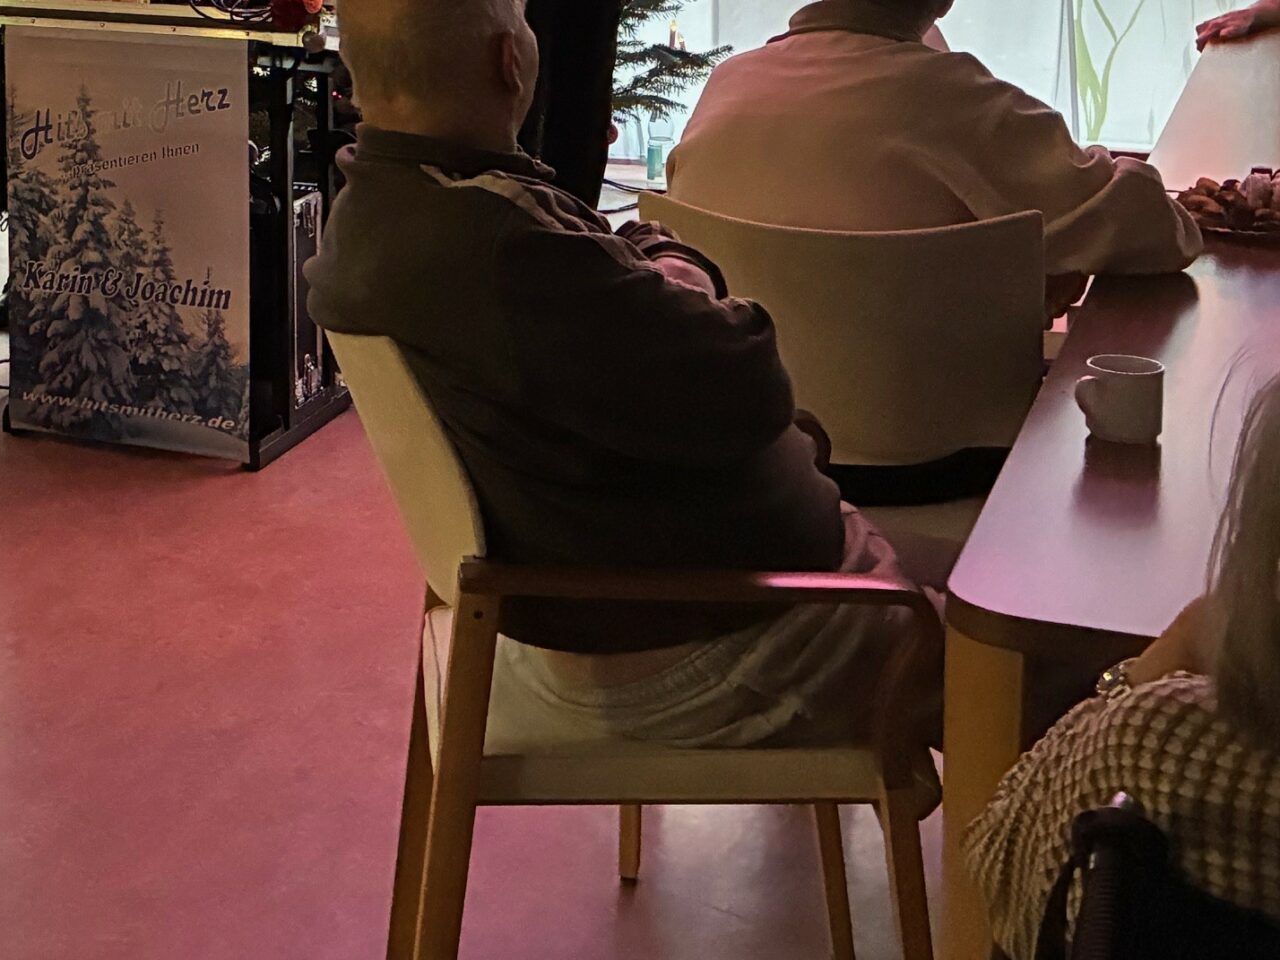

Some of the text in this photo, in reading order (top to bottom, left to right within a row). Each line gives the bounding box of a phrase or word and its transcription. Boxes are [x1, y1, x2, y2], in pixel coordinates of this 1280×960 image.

[151, 79, 231, 134] Herz
[161, 143, 200, 158] Ihnen
[23, 261, 232, 309] Karin & Joachim
[22, 391, 235, 430] www.hitsmitherz.de
